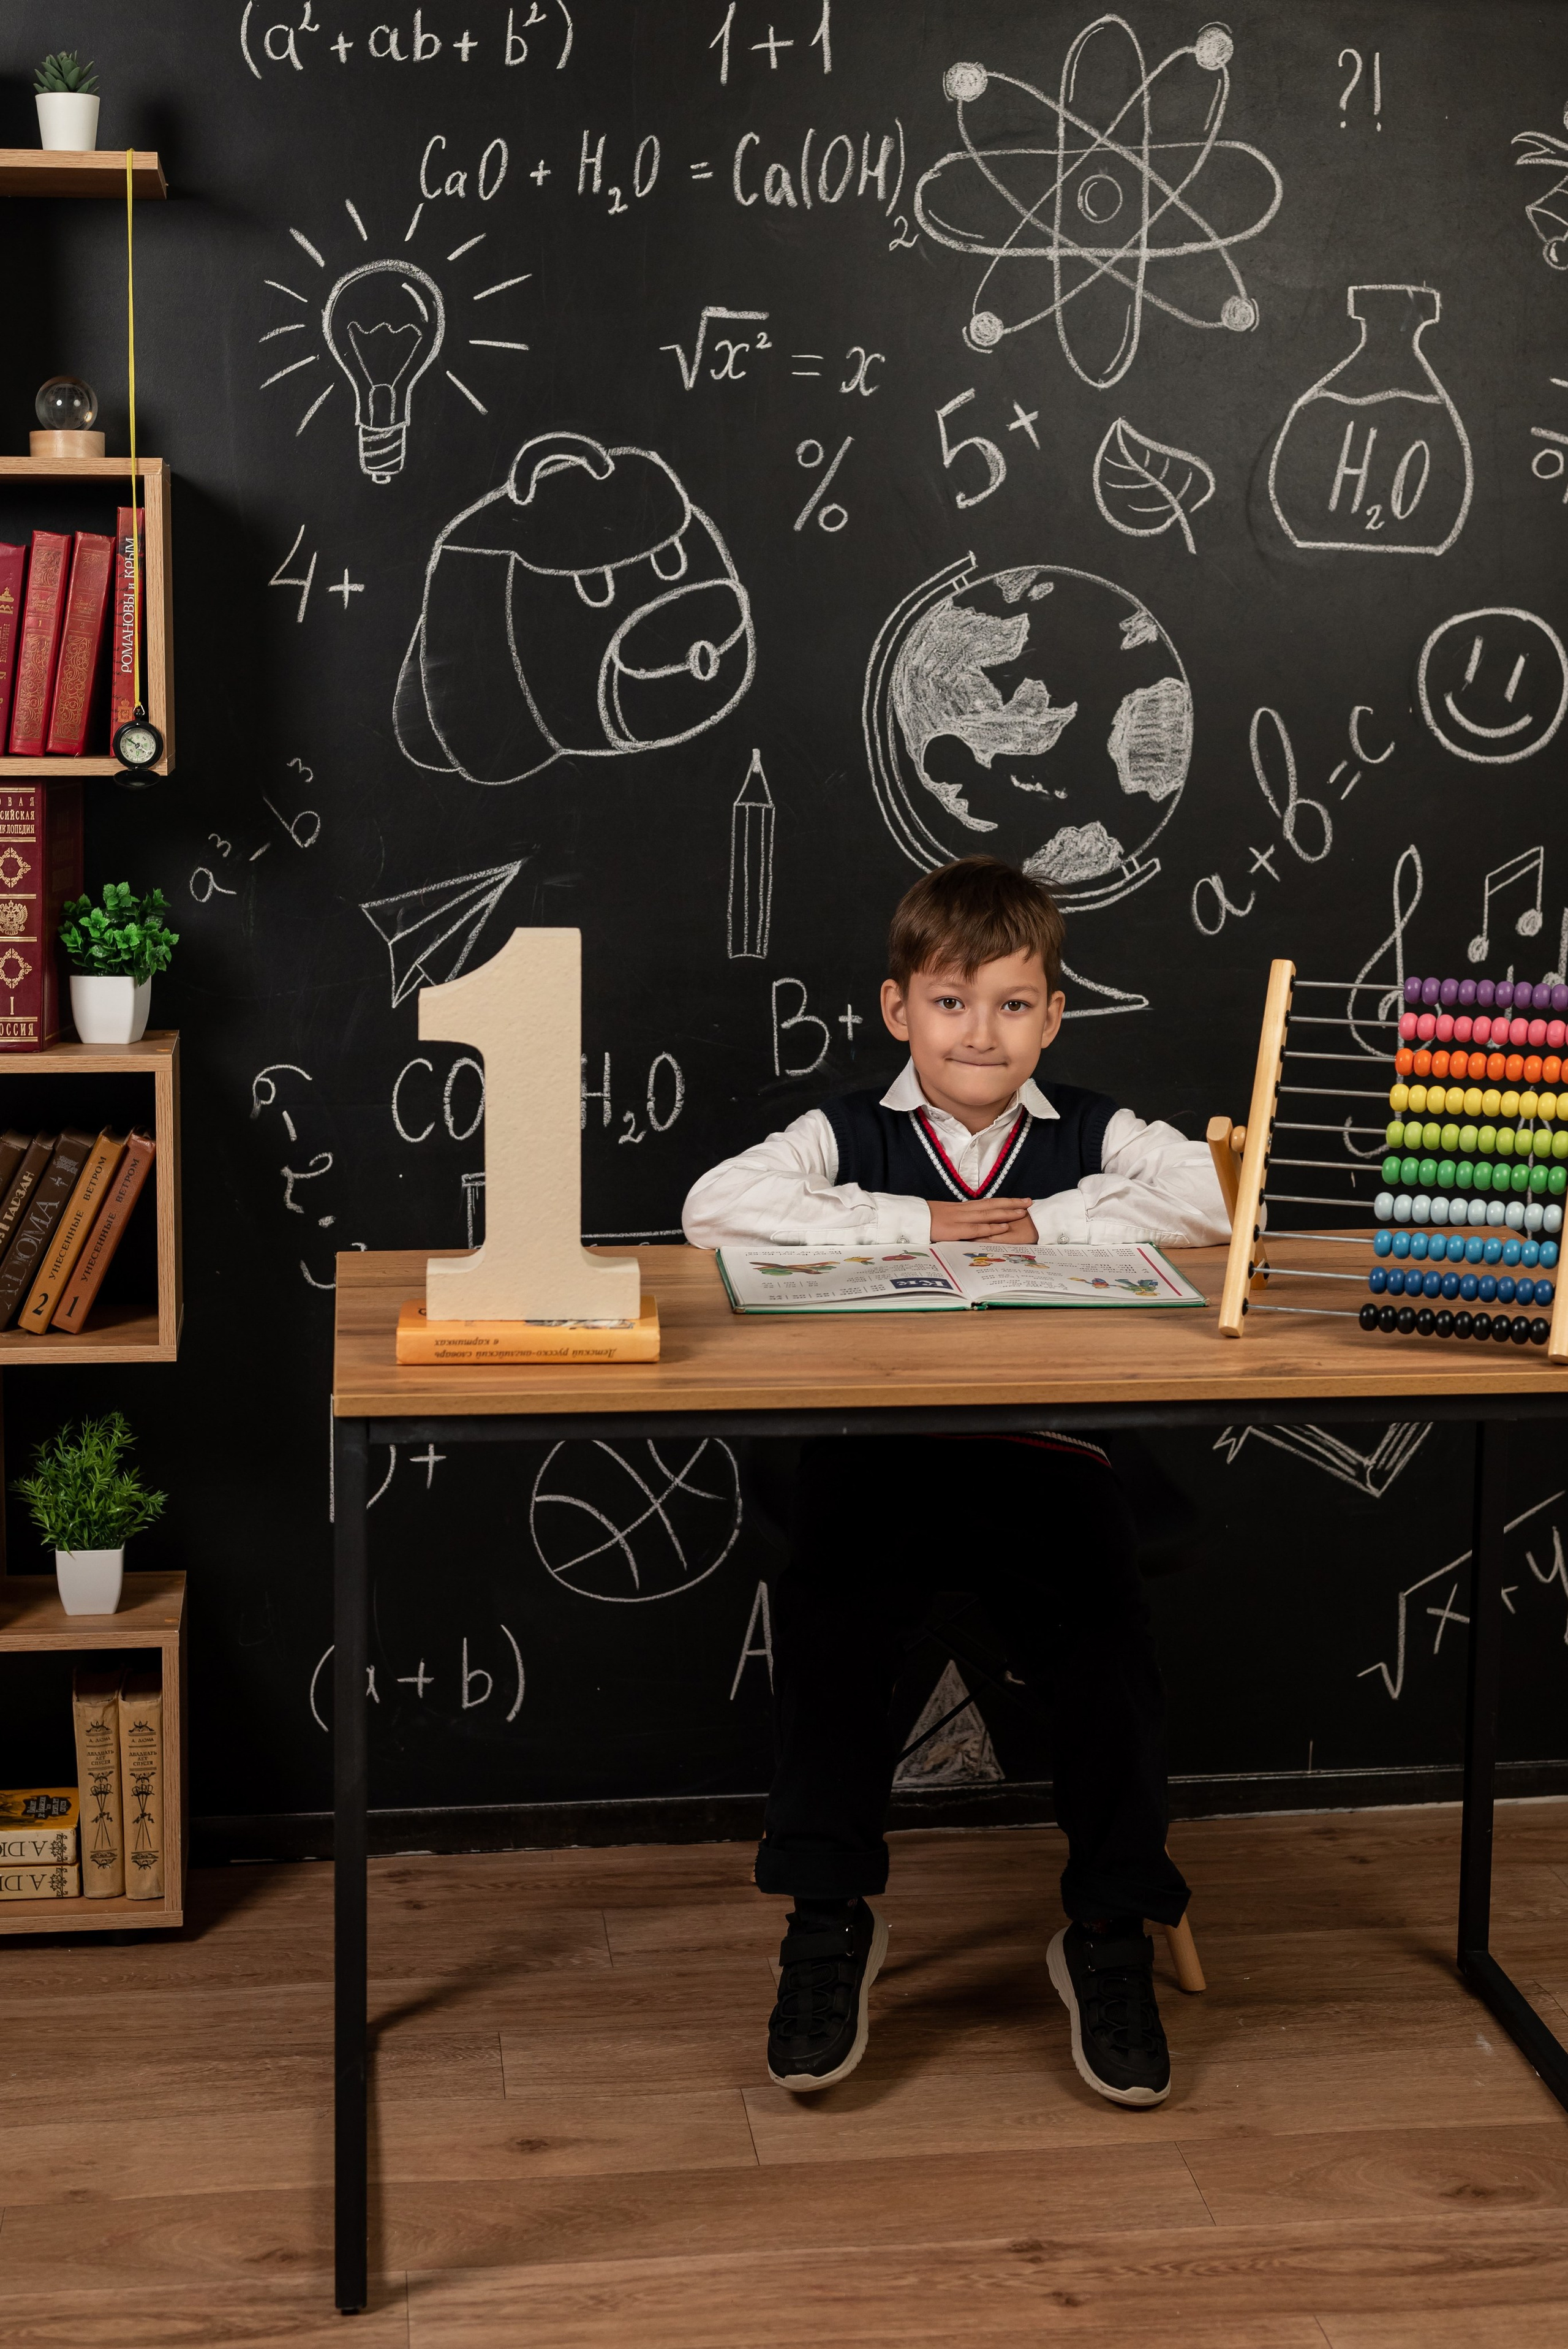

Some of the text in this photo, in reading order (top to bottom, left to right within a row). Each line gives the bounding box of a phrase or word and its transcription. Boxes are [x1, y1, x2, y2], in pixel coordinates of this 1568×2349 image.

[1338, 48, 1382, 132] ?!
[794, 436, 854, 532] %
[124, 537, 135, 580] КРЫМ
[121, 593, 134, 673] РОМАНОВЫ
[0, 796, 34, 806] ВАЯ
[49, 1209, 85, 1280] УНЕСЕННЫЕ
[83, 1156, 107, 1201] ВЕТРОМ
[81, 1158, 140, 1282] УНЕСЕННЫЕ ВЕТРОМ
[32, 1293, 49, 1316] 2
[66, 1296, 80, 1318] 1
[434, 1337, 490, 1347] картинках
[434, 1348, 617, 1359] Детский русско-английский словарь
[730, 1581, 774, 1700] A
